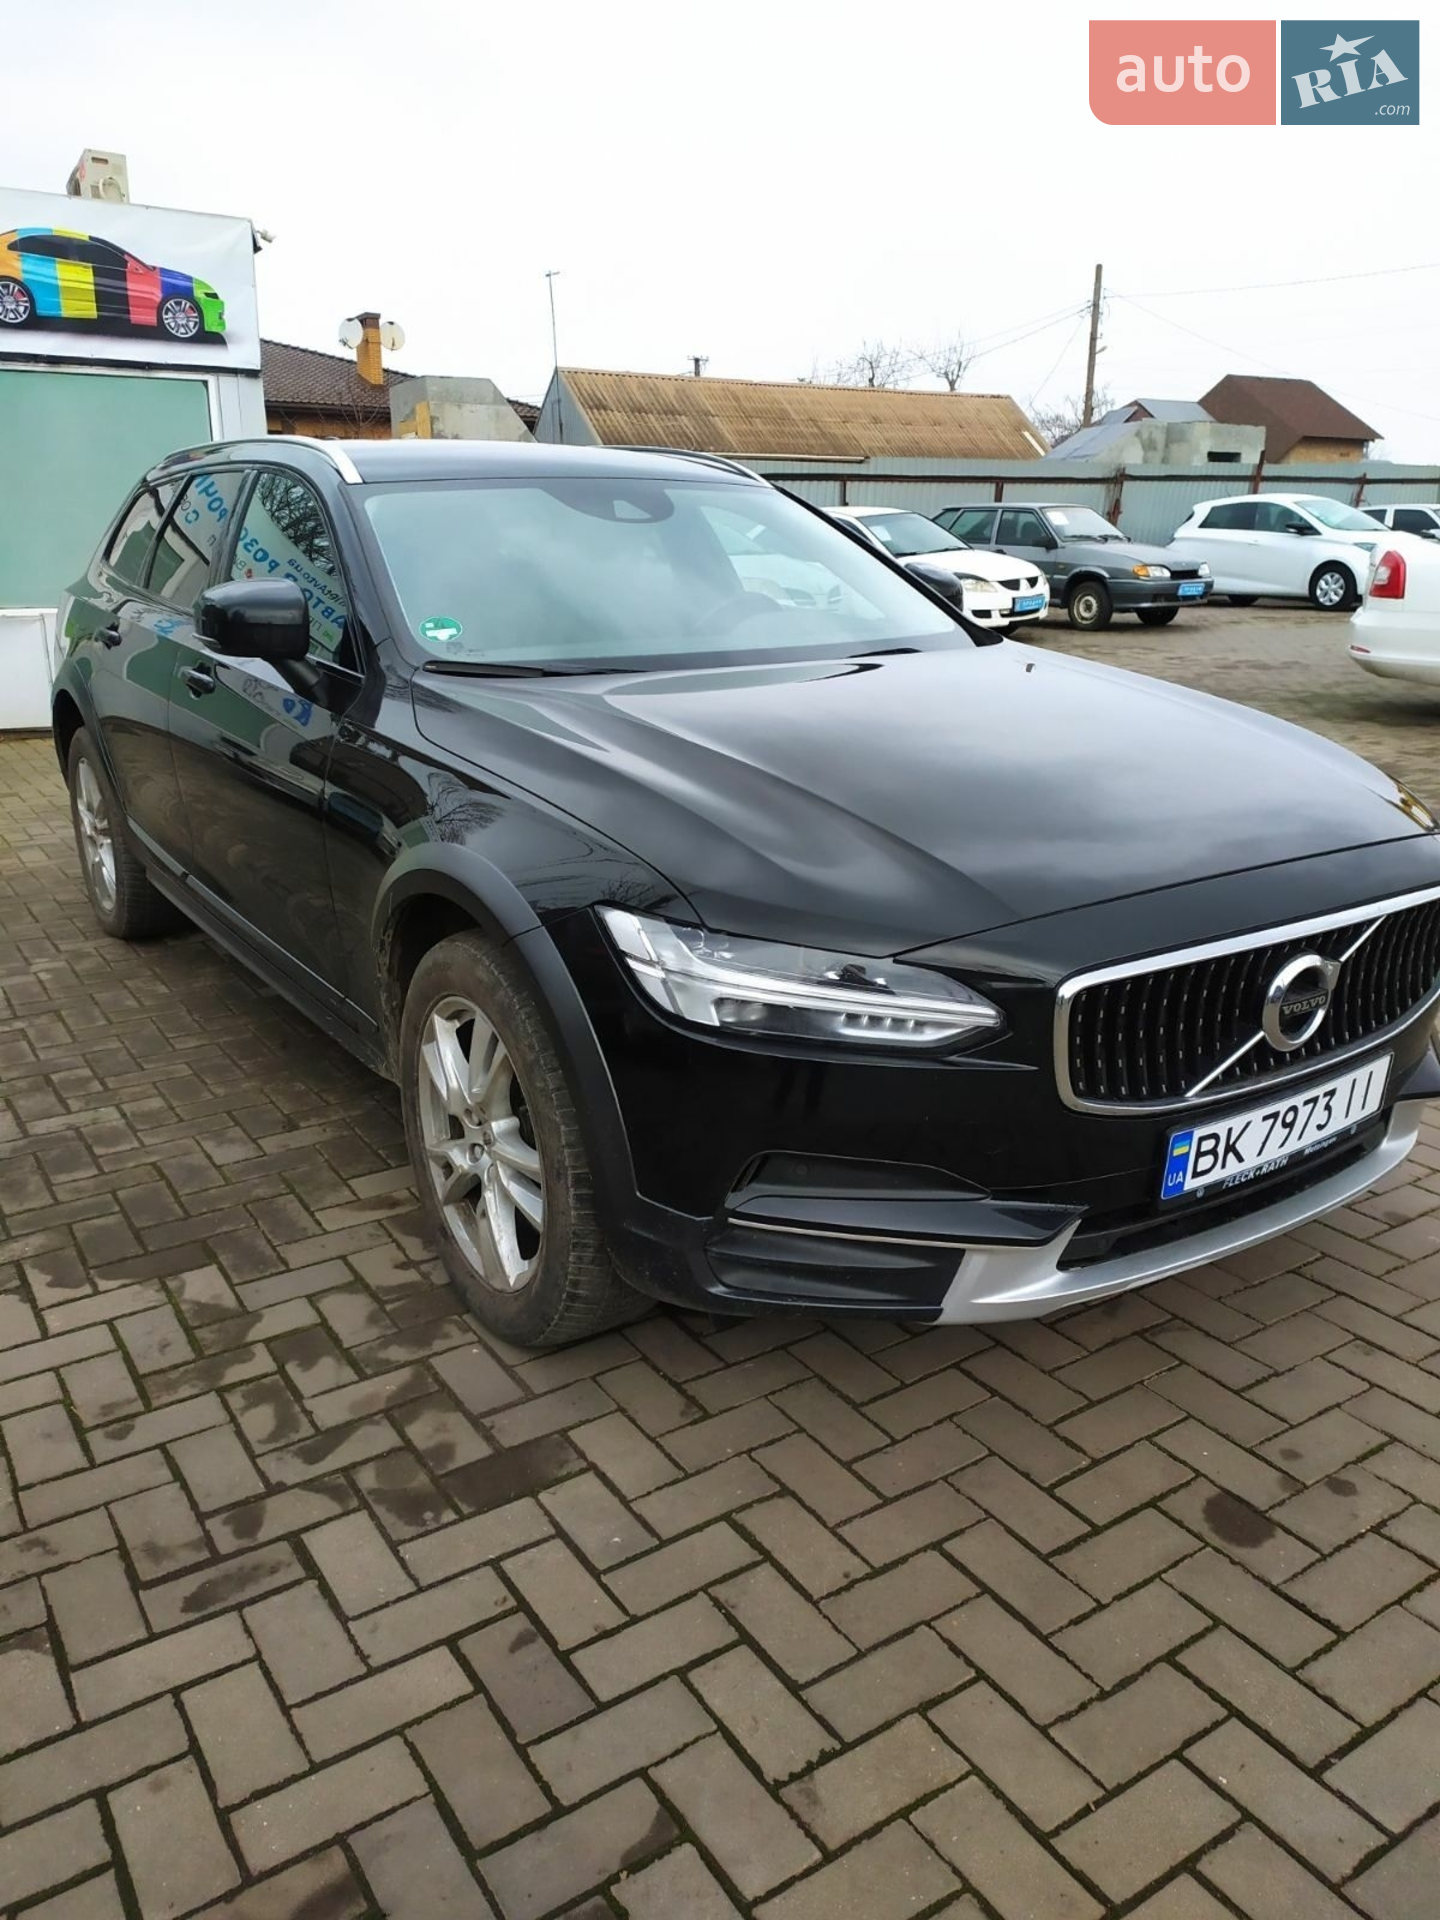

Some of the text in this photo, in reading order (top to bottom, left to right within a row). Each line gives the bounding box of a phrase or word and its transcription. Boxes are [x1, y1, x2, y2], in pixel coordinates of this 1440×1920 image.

[1282, 995, 1326, 1015] VOLVO
[1191, 1120, 1253, 1180] BK
[1256, 1088, 1338, 1158] 7973
[1167, 1171, 1184, 1187] UA
